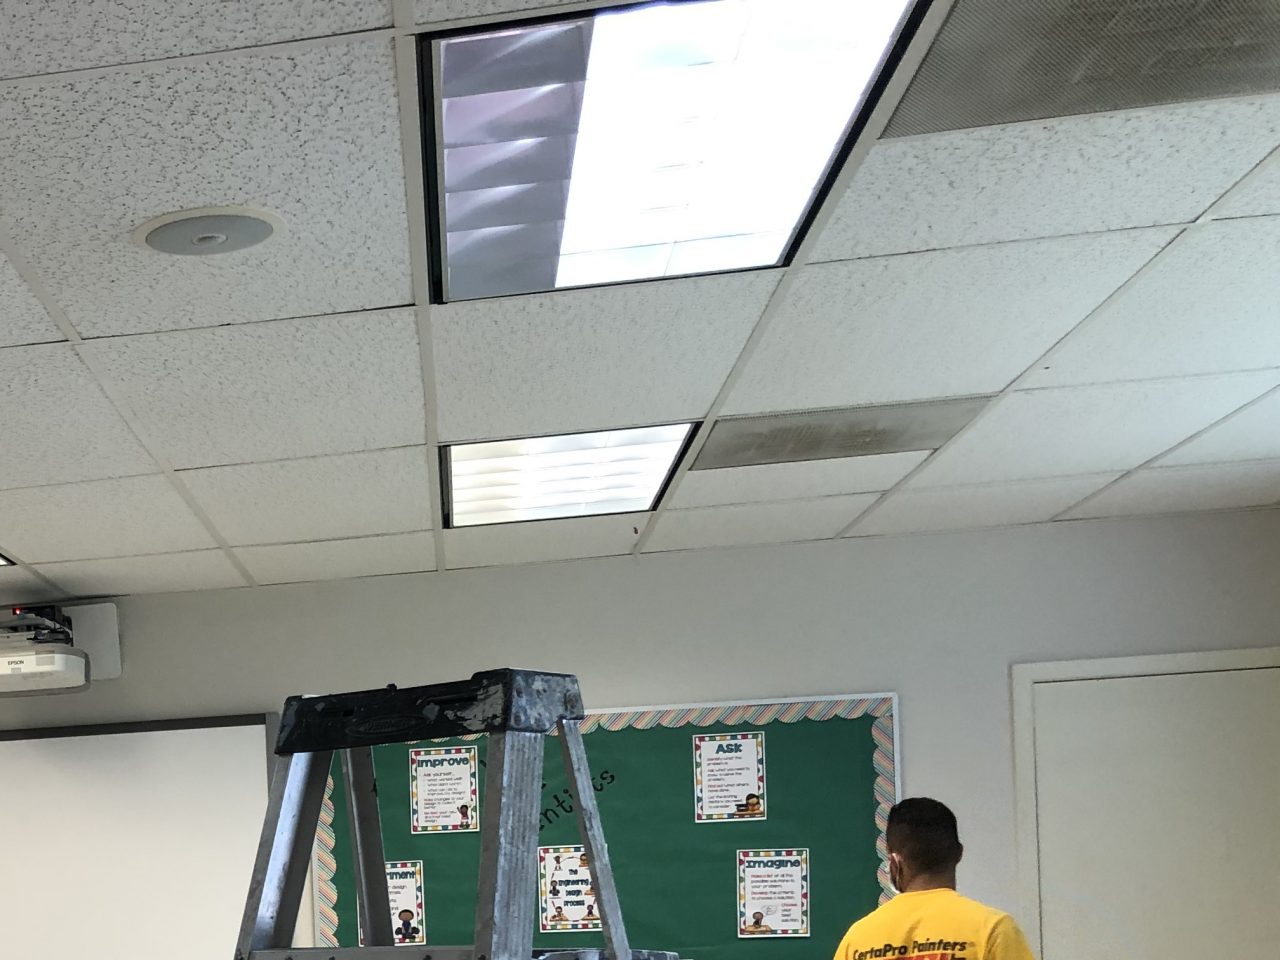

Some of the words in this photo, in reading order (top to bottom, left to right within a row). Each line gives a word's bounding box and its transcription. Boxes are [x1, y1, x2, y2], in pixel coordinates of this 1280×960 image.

[715, 743, 743, 754] Ask
[417, 757, 470, 768] Improve
[745, 859, 801, 869] Imagine
[912, 938, 968, 954] Painters
